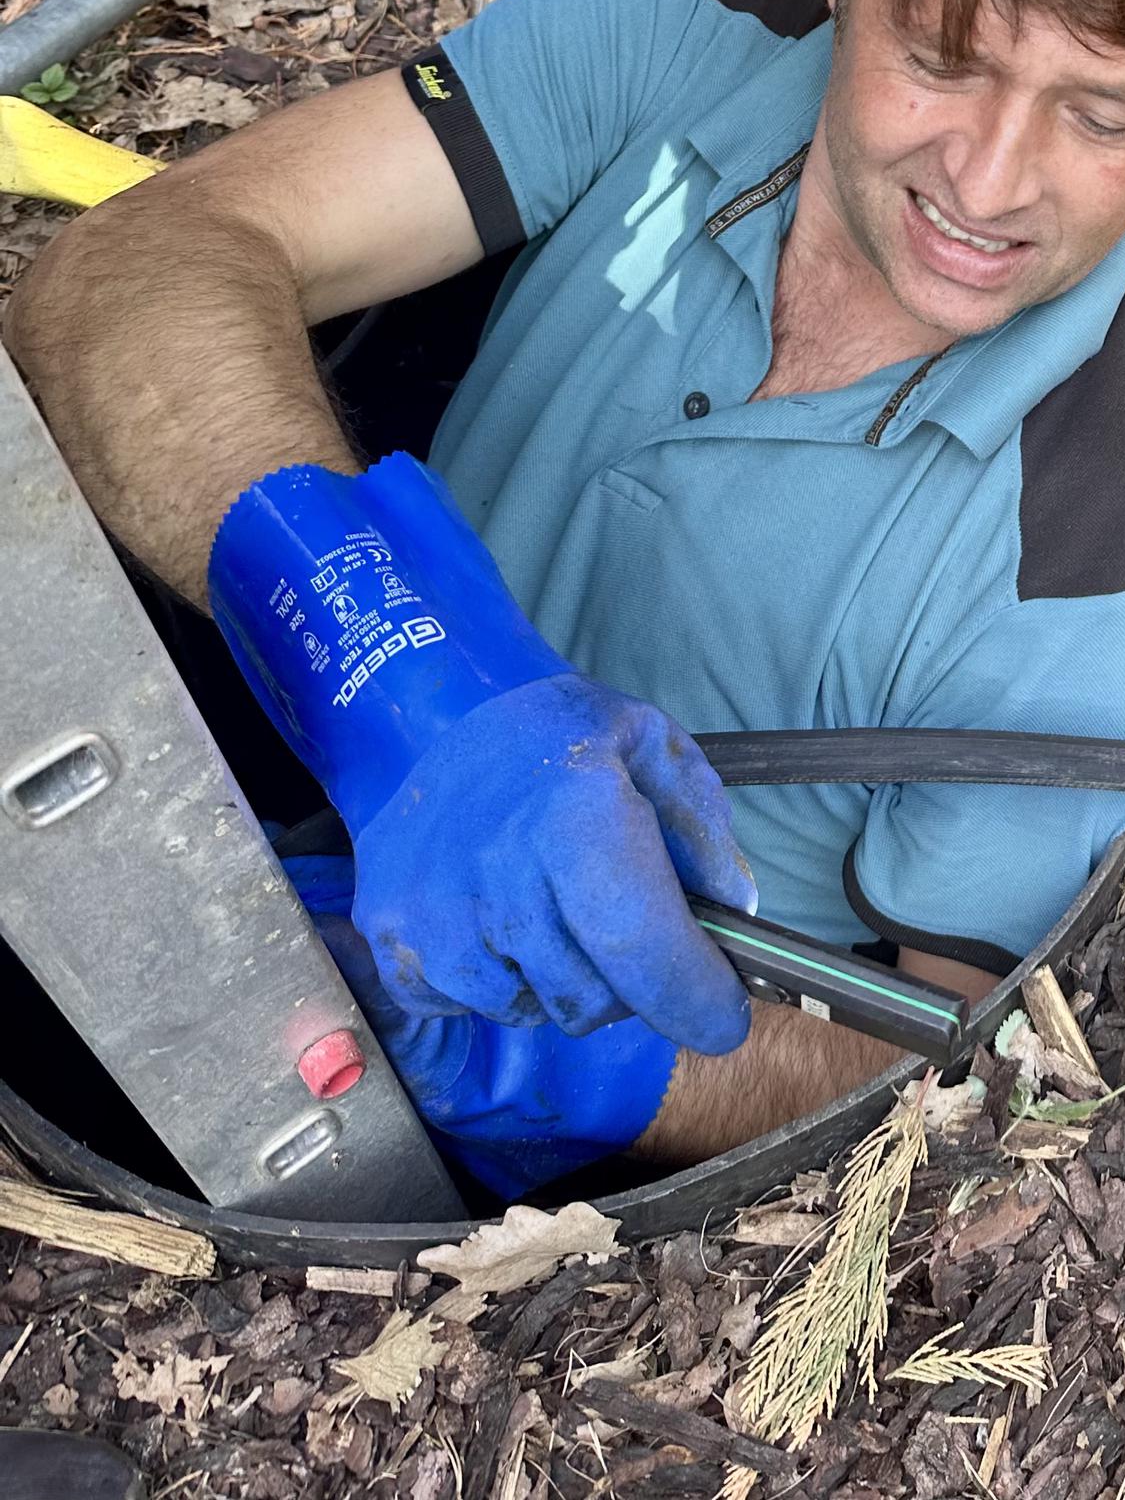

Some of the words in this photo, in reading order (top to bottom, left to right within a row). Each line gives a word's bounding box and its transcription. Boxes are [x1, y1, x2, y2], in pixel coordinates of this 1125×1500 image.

[725, 184, 776, 218] WORKWEAR
[276, 588, 298, 619] 10/XL
[289, 609, 306, 632] Size
[361, 620, 393, 648] BLUE
[332, 633, 408, 708] GEBOL
[339, 646, 363, 672] TECH
